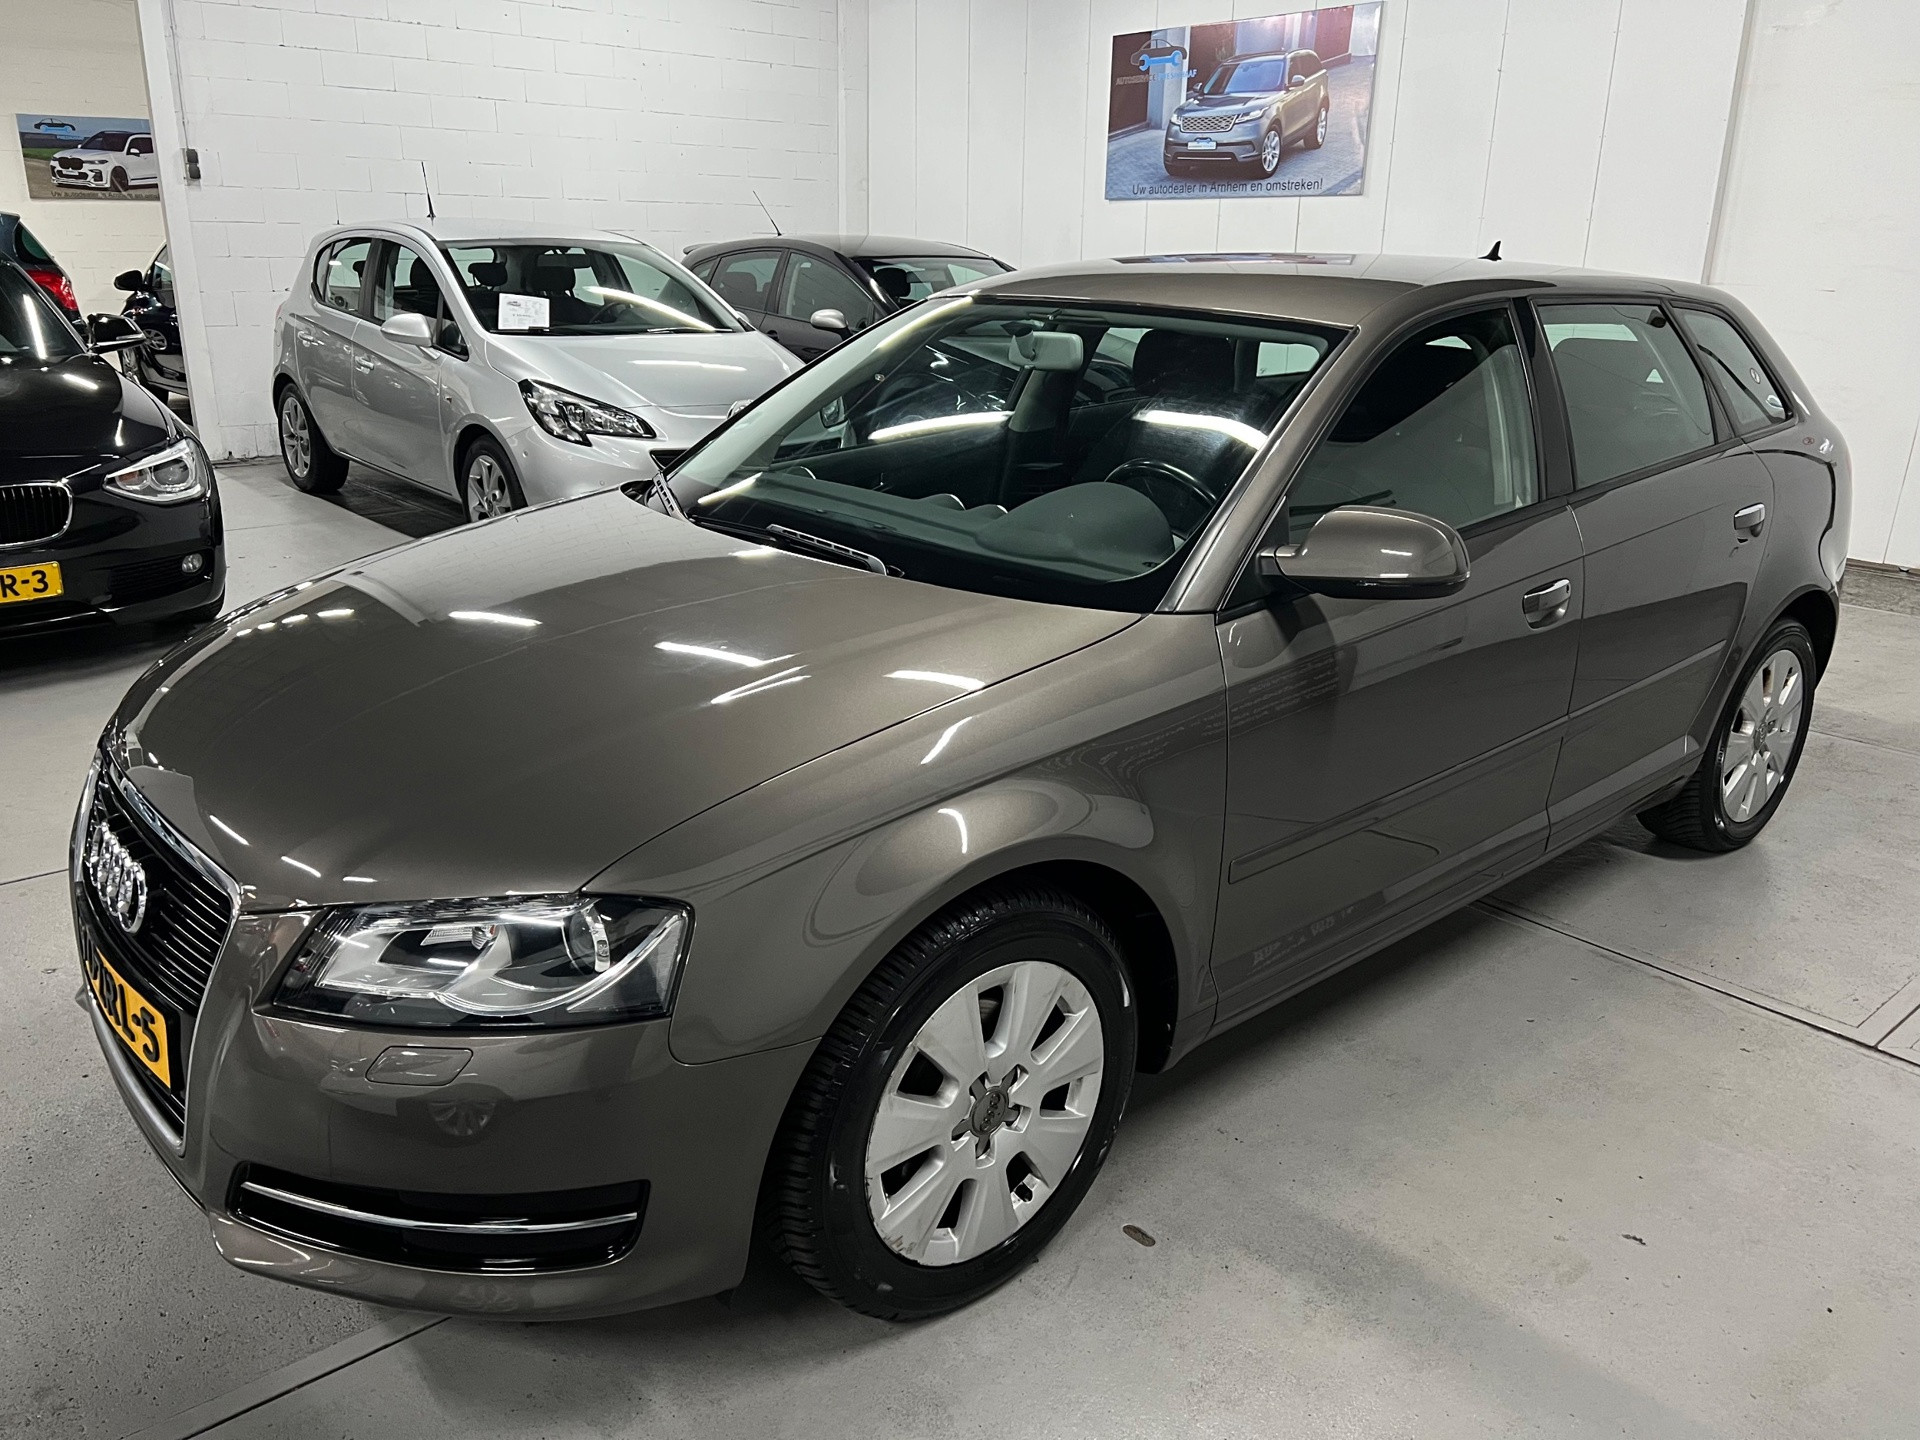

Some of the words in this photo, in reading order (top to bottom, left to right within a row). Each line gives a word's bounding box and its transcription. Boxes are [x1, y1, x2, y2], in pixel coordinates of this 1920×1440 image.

[1132, 183, 1147, 195] Uw
[1148, 182, 1197, 194] autodealer
[1199, 182, 1207, 193] in
[1209, 180, 1247, 192] Arnhem
[1250, 181, 1263, 192] en
[1265, 178, 1323, 191] omstreken!
[0, 570, 49, 598] R-3
